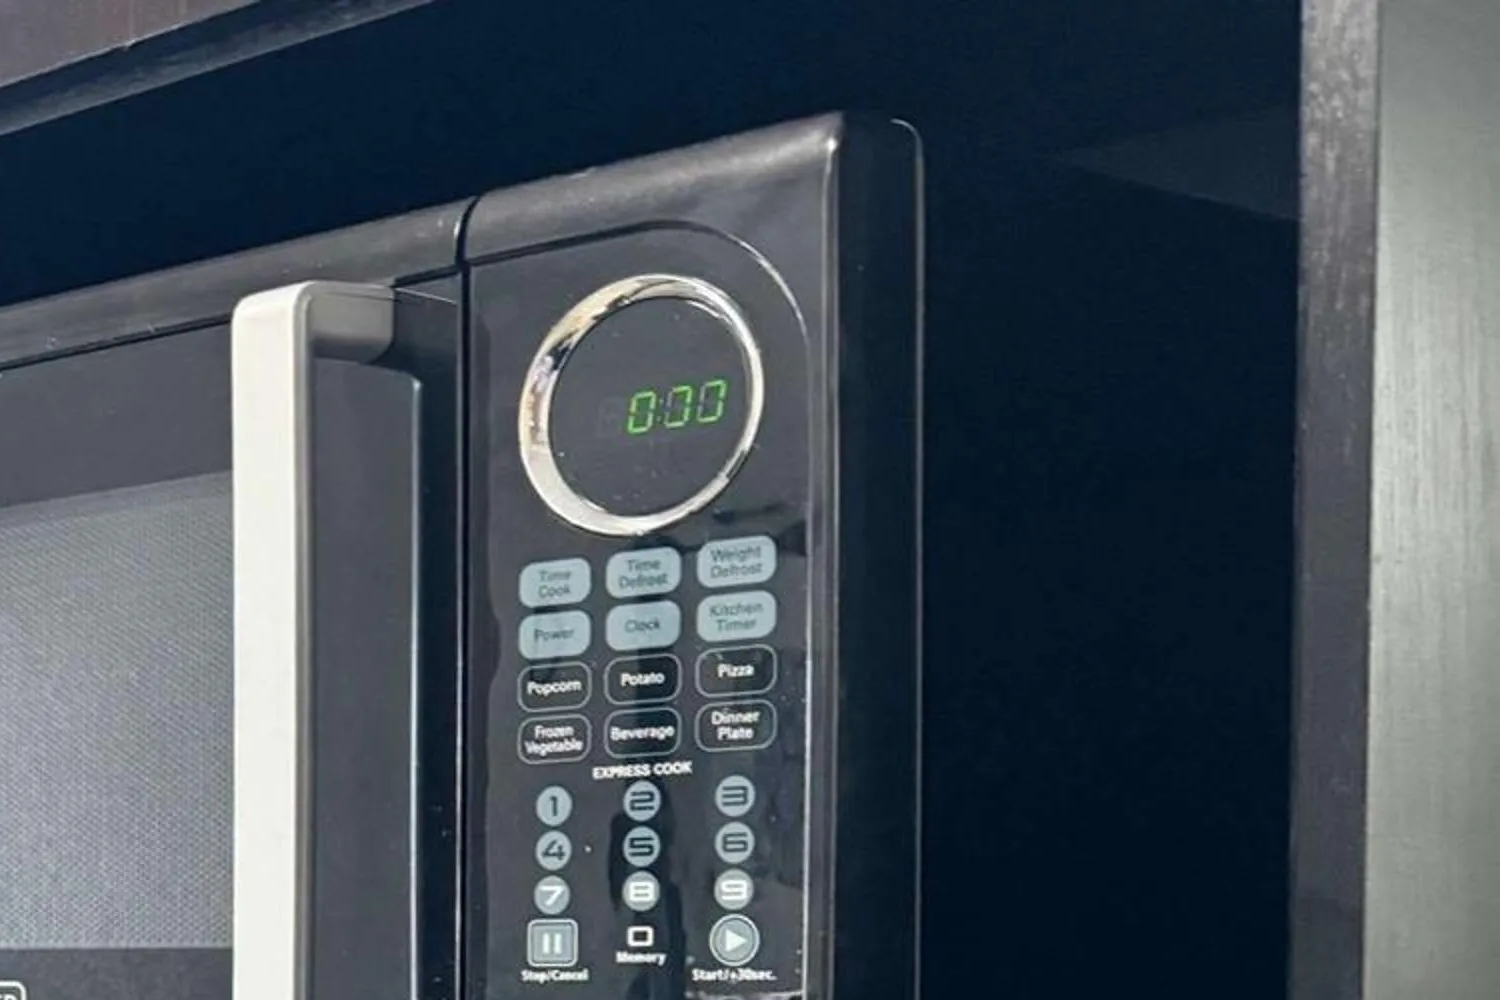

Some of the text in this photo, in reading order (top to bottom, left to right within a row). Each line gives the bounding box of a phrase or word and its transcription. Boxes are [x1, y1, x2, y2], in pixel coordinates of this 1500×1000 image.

[627, 379, 728, 434] 0:00
[628, 559, 660, 572] Time
[619, 573, 668, 589] Defrost
[538, 584, 570, 598] Cook
[709, 603, 763, 618] Kitchen
[625, 617, 660, 633] Clock
[717, 618, 757, 632] Timer
[533, 628, 575, 643] Power
[620, 671, 665, 687] Potato
[718, 663, 754, 679] Pizza
[527, 680, 582, 697] Popcorn
[711, 711, 760, 726] Dinner
[534, 725, 575, 740] Frozen
[610, 725, 675, 741] Beverage
[717, 725, 754, 741] Plate
[524, 738, 584, 757] Vegetable
[592, 760, 693, 780] EXPRESS COOK
[630, 791, 655, 811] 2
[721, 785, 748, 806] 3
[541, 840, 566, 861] 4
[630, 837, 655, 857] 5
[540, 886, 563, 907] 7
[615, 952, 666, 965] Memory
[521, 969, 589, 982] Stop/Cancel
